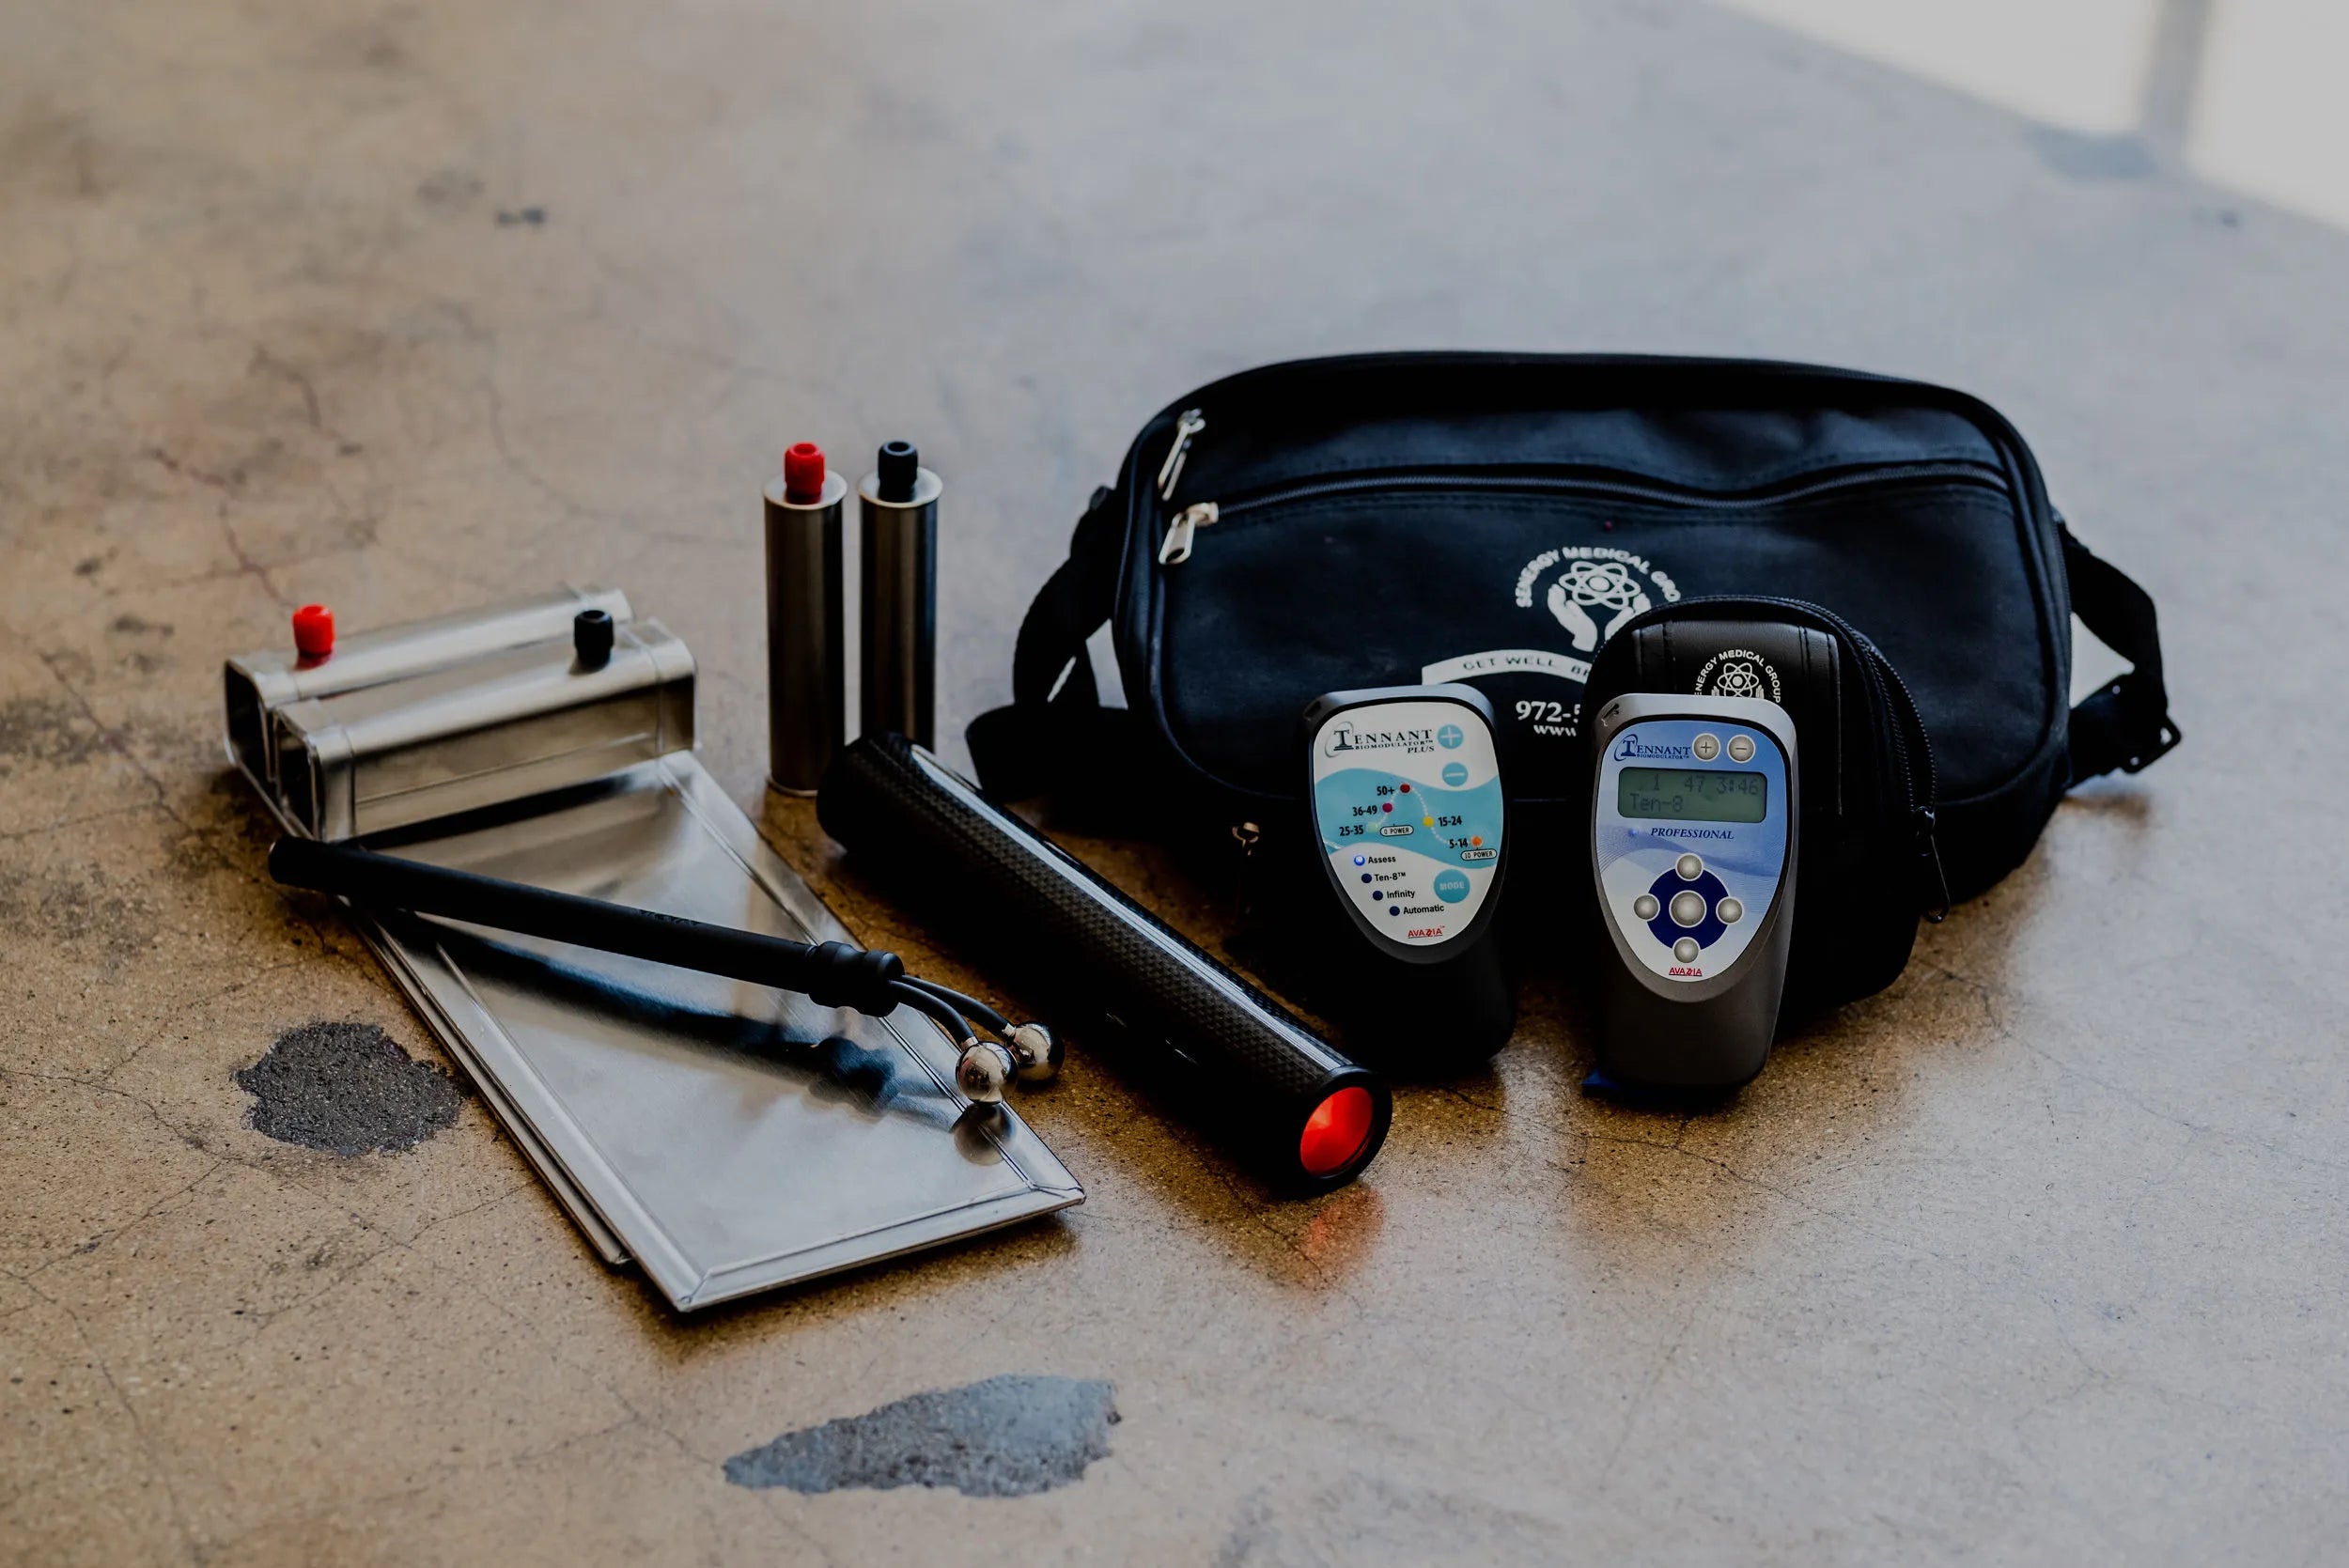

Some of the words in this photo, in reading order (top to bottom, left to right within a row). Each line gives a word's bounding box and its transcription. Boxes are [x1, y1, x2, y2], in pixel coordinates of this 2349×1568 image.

[1562, 547, 1650, 574] MEDICAL
[1463, 658, 1495, 671] GET
[1506, 657, 1555, 668] WELL
[1719, 649, 1765, 667] MEDICAL
[1765, 665, 1781, 703] GROUP
[1333, 729, 1433, 752] TENNANT
[1407, 745, 1435, 754] PLUS
[1622, 739, 1691, 757] TENNANT
[1653, 773, 1660, 791] 1
[1685, 775, 1706, 792] 47
[1717, 776, 1759, 796] 3:46
[1377, 785, 1395, 796] 50+
[1629, 793, 1684, 813] Ten-8
[1352, 805, 1377, 816] 36-49
[1438, 815, 1462, 827] 15-24
[1339, 826, 1364, 836] 25-35
[1650, 828, 1735, 840] PROFESSIONAL
[1449, 838, 1469, 849] 5-14
[1368, 856, 1396, 864] Assess
[1439, 881, 1465, 892] MODE
[1387, 890, 1415, 899] Infinity
[1403, 904, 1445, 915] Automatic
